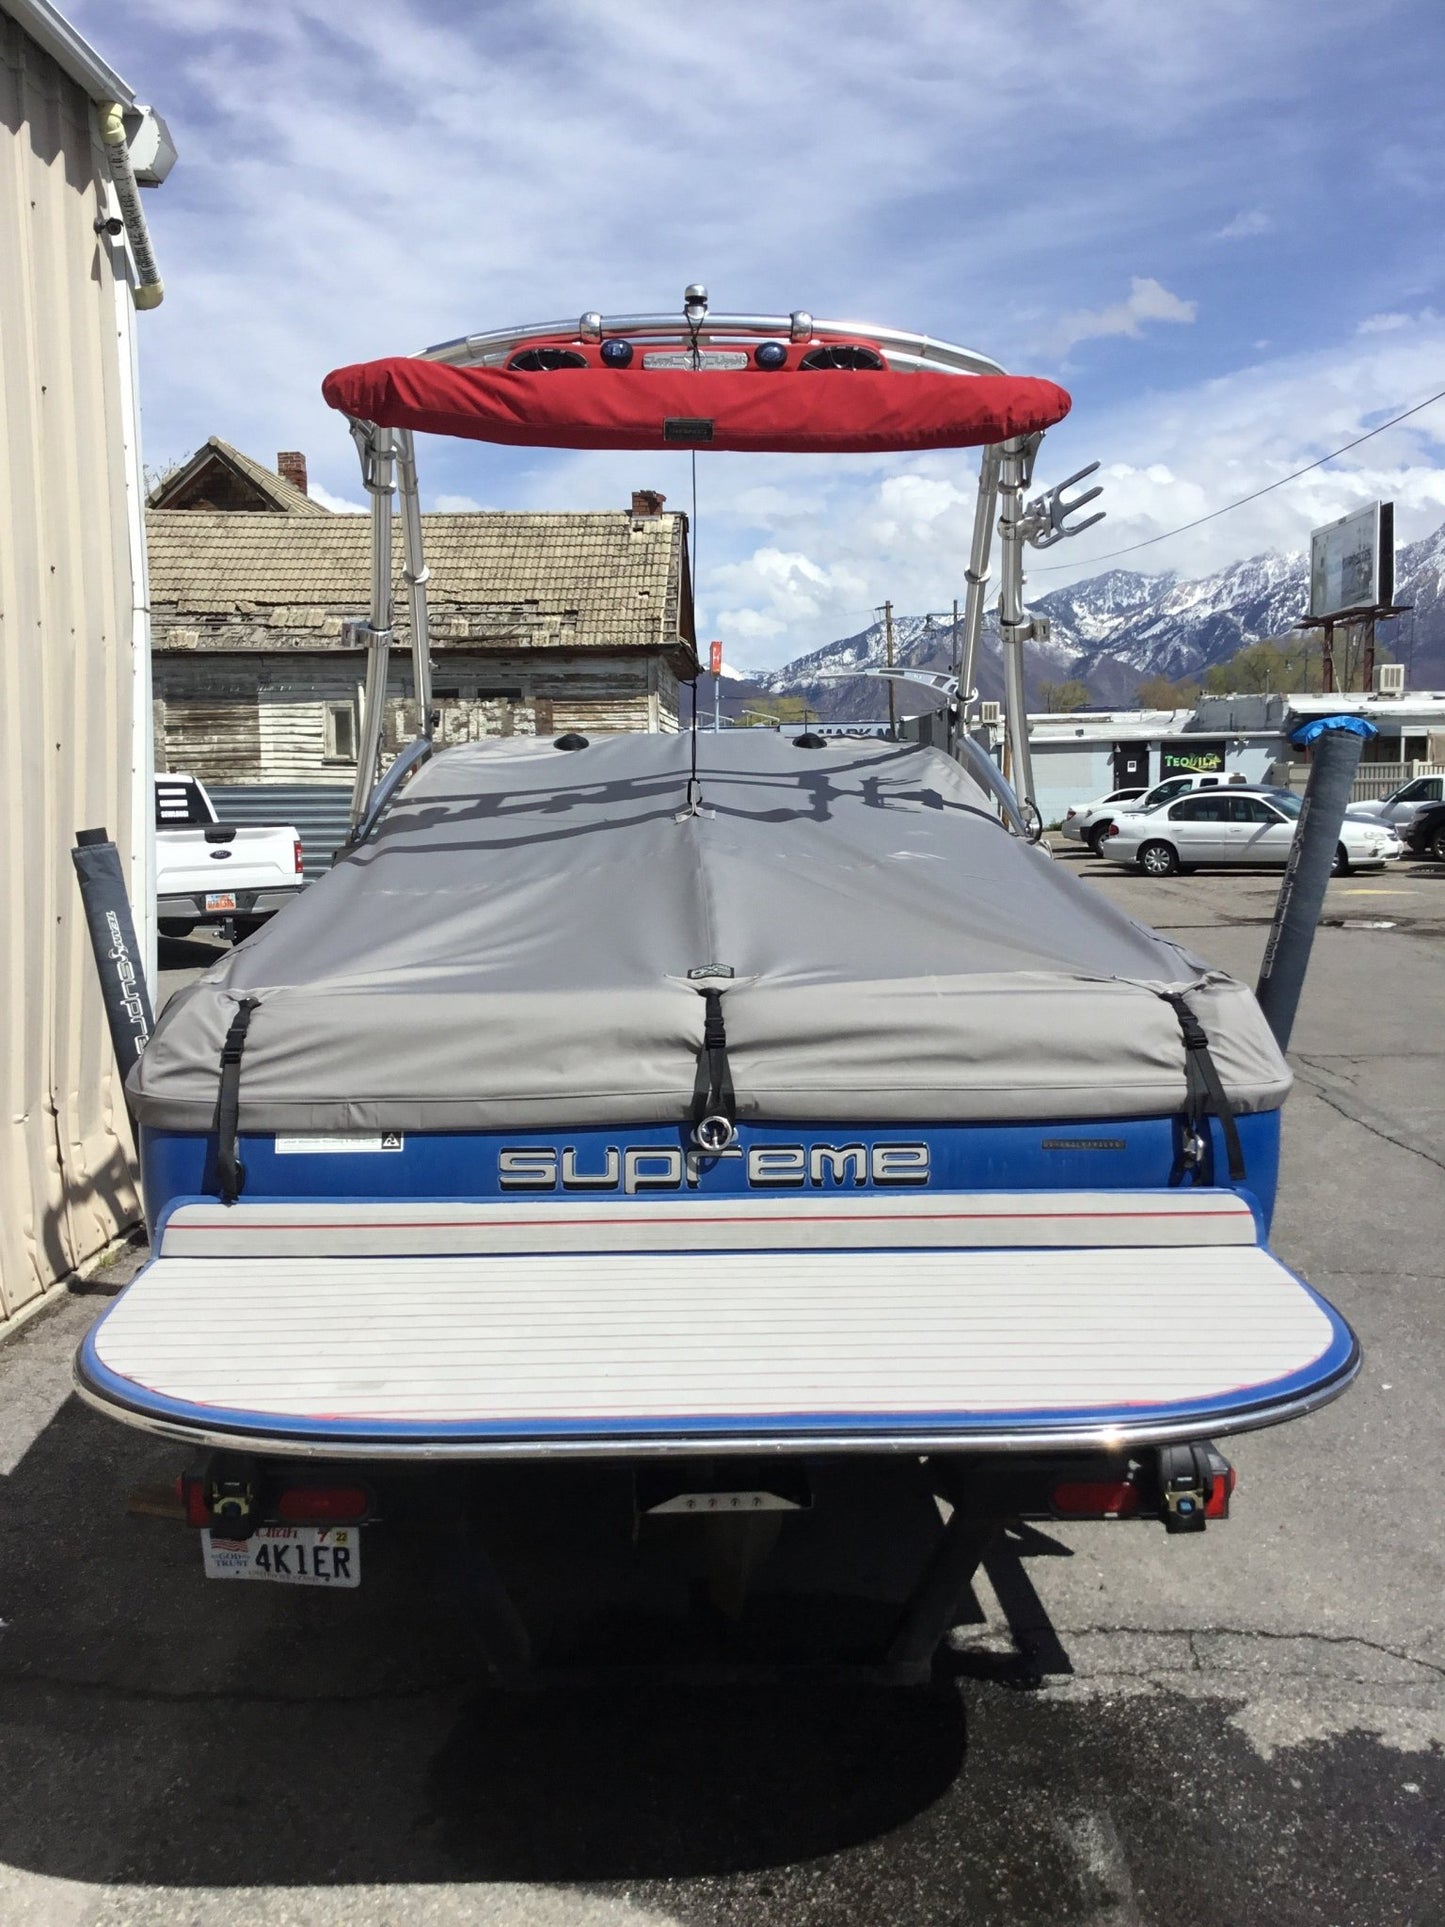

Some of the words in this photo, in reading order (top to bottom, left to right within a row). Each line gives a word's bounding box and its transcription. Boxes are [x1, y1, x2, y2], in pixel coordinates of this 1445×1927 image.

[1164, 755, 1217, 767] TEQUILA
[106, 910, 124, 949] TEAM
[117, 960, 150, 1056] supre
[499, 1142, 929, 1195] supreme
[335, 1531, 348, 1542] 22
[255, 1543, 351, 1578] 4K1ER
